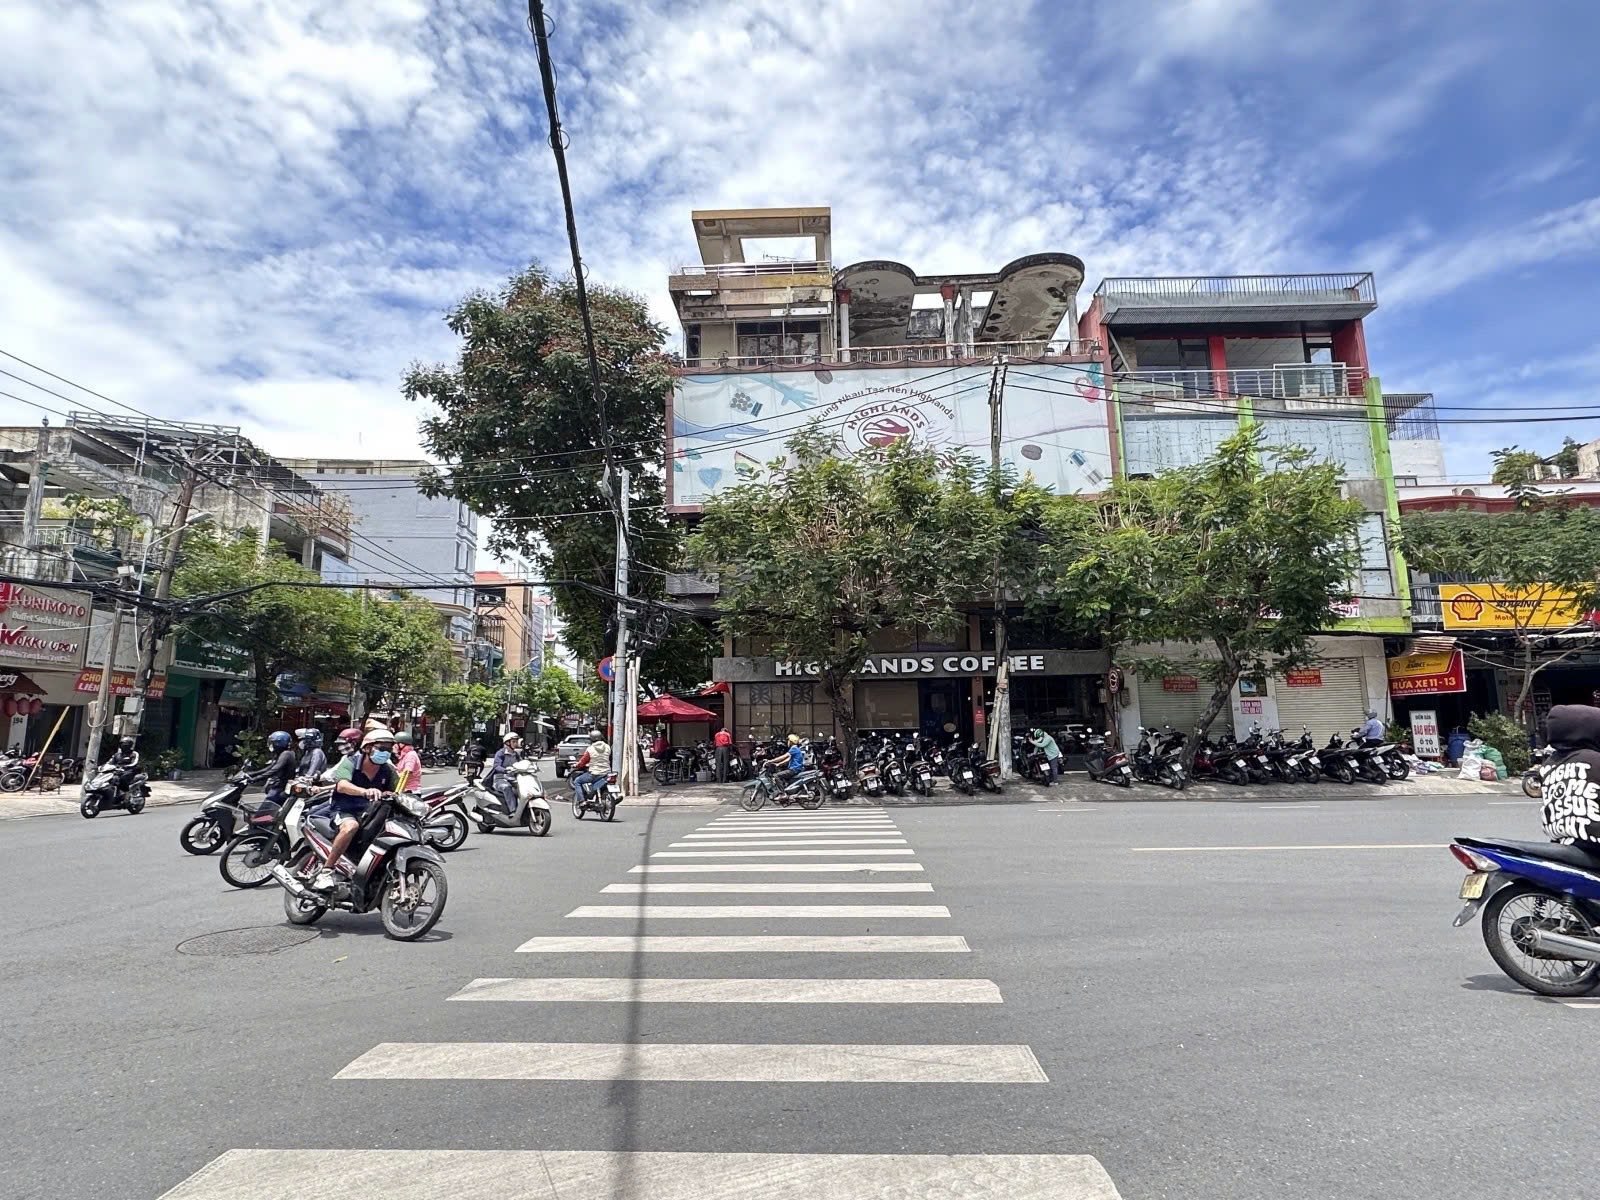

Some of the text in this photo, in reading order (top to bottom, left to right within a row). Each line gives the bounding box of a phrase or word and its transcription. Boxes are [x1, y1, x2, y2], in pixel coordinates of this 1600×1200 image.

[909, 388, 956, 420] Highlands
[847, 403, 926, 430] HIGHLANDS
[775, 655, 1045, 676] HIGANDS COFEE
[1393, 678, 1413, 690] RỬA
[1415, 680, 1428, 688] XE
[1444, 677, 1456, 686] 13
